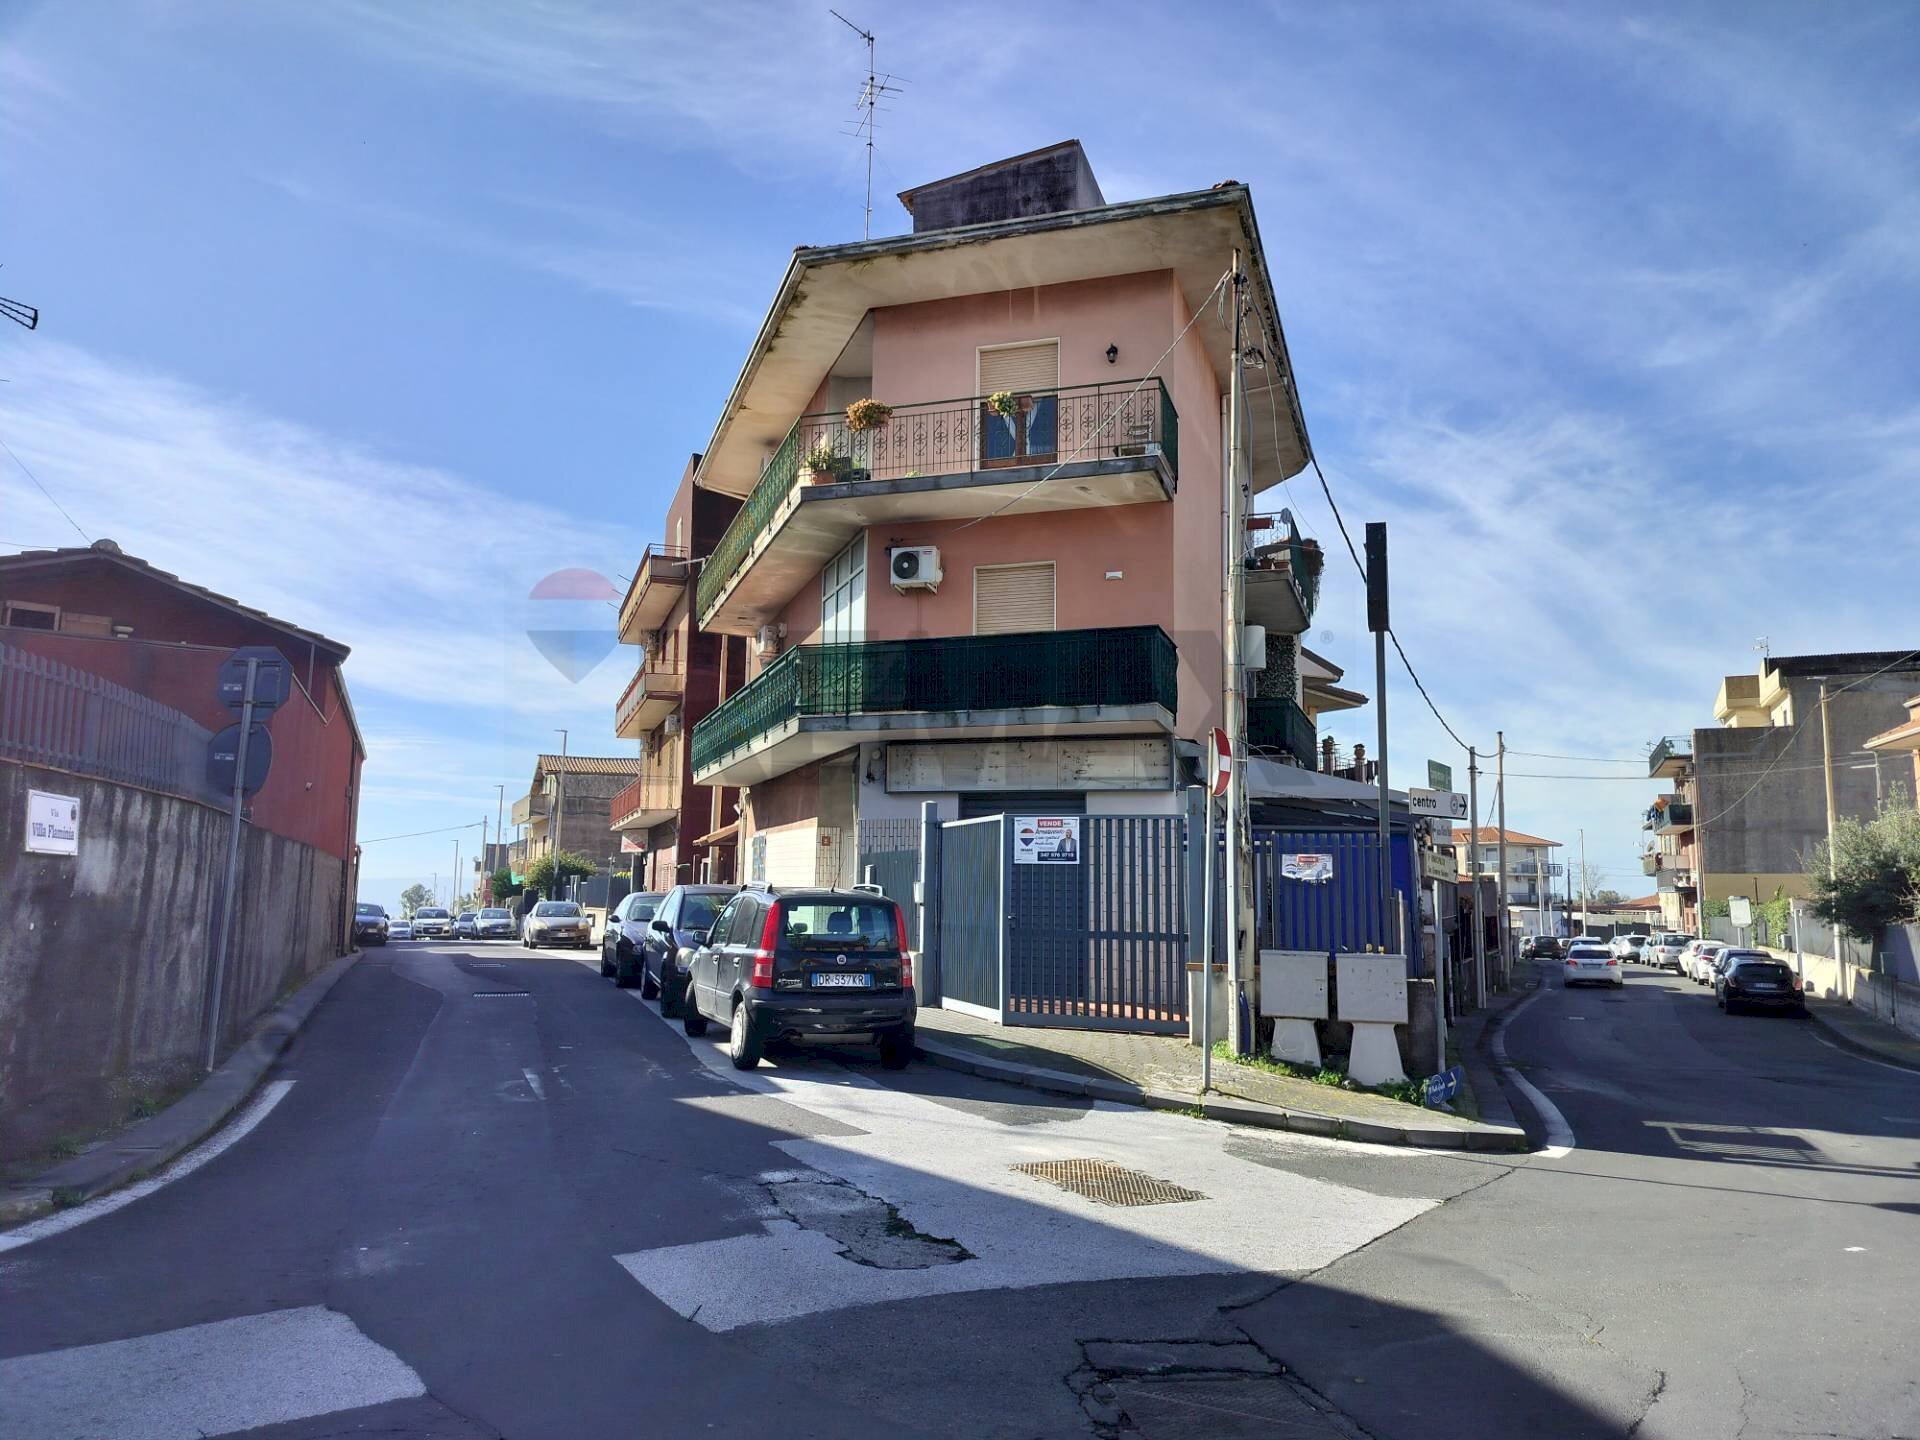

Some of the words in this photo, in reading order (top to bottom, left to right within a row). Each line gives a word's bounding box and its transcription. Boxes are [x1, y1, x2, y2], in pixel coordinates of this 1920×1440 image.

[1412, 796, 1437, 809] centro
[51, 808, 59, 817] Via
[32, 822, 46, 837] Villa
[48, 824, 75, 840] Flaminia
[819, 974, 831, 986] DR
